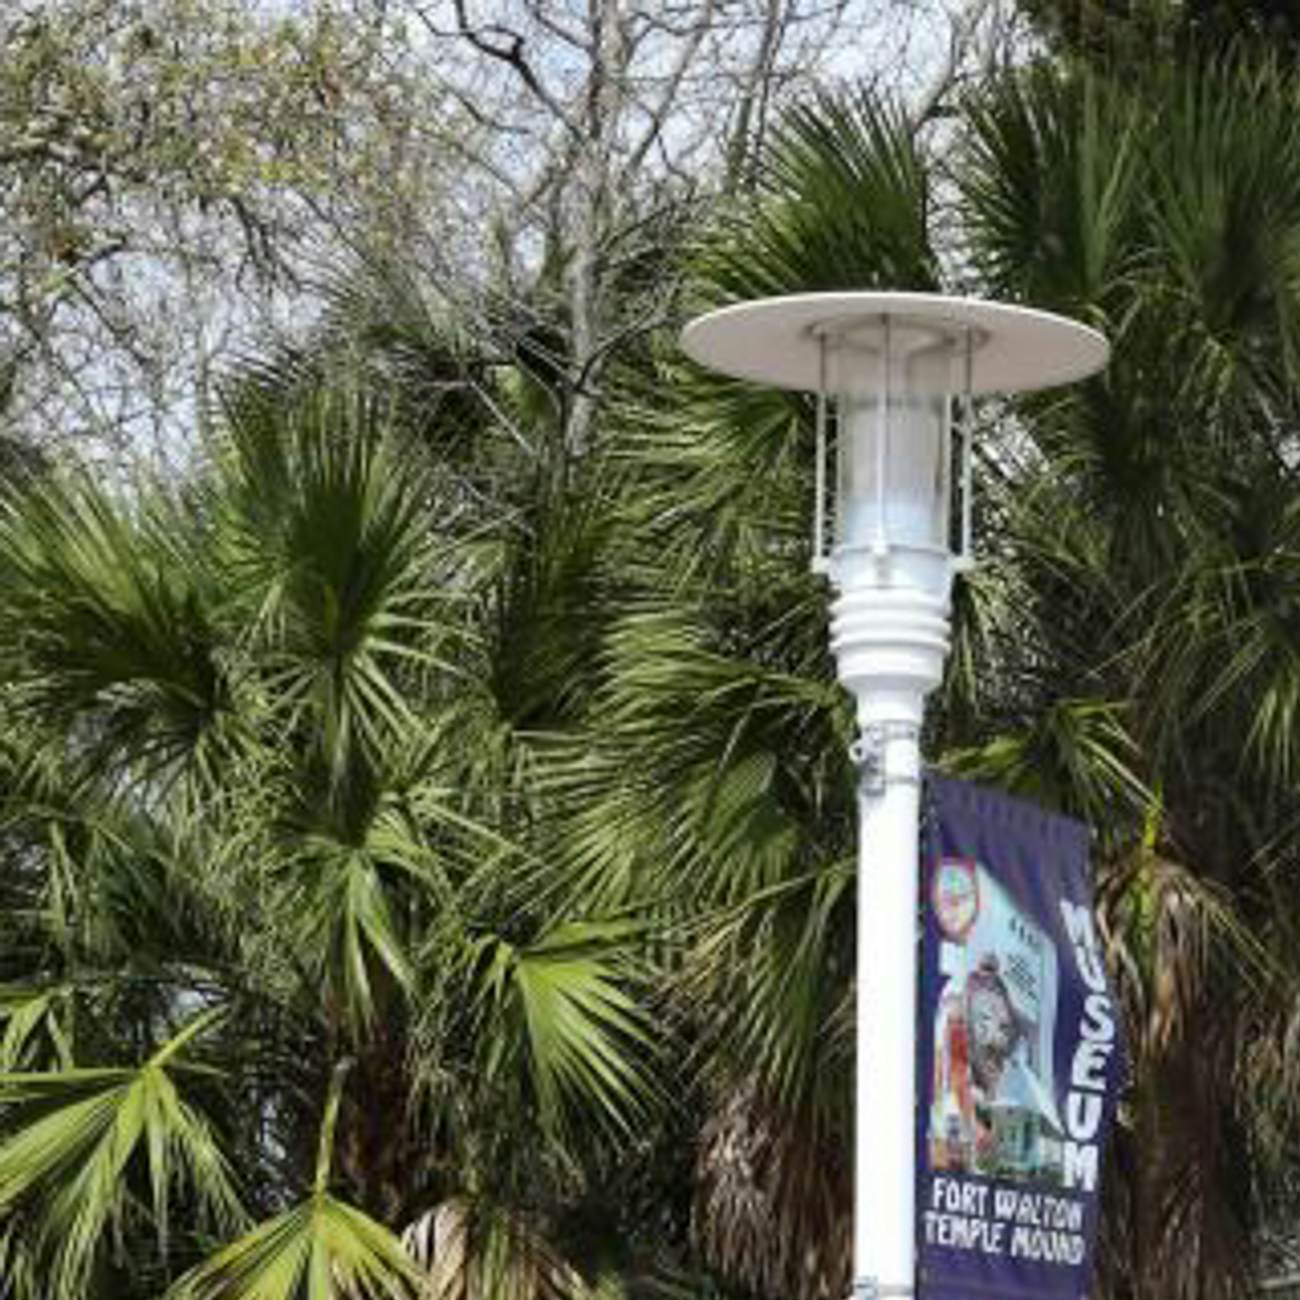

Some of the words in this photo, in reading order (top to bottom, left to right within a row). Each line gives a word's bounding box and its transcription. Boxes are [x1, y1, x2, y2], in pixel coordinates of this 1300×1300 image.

[1060, 899, 1115, 1192] MUSEUM
[933, 1177, 989, 1216] FORT
[995, 1189, 1083, 1231] WALTON
[925, 1210, 1005, 1253] TEMPLE
[1010, 1226, 1085, 1265] MOUND
